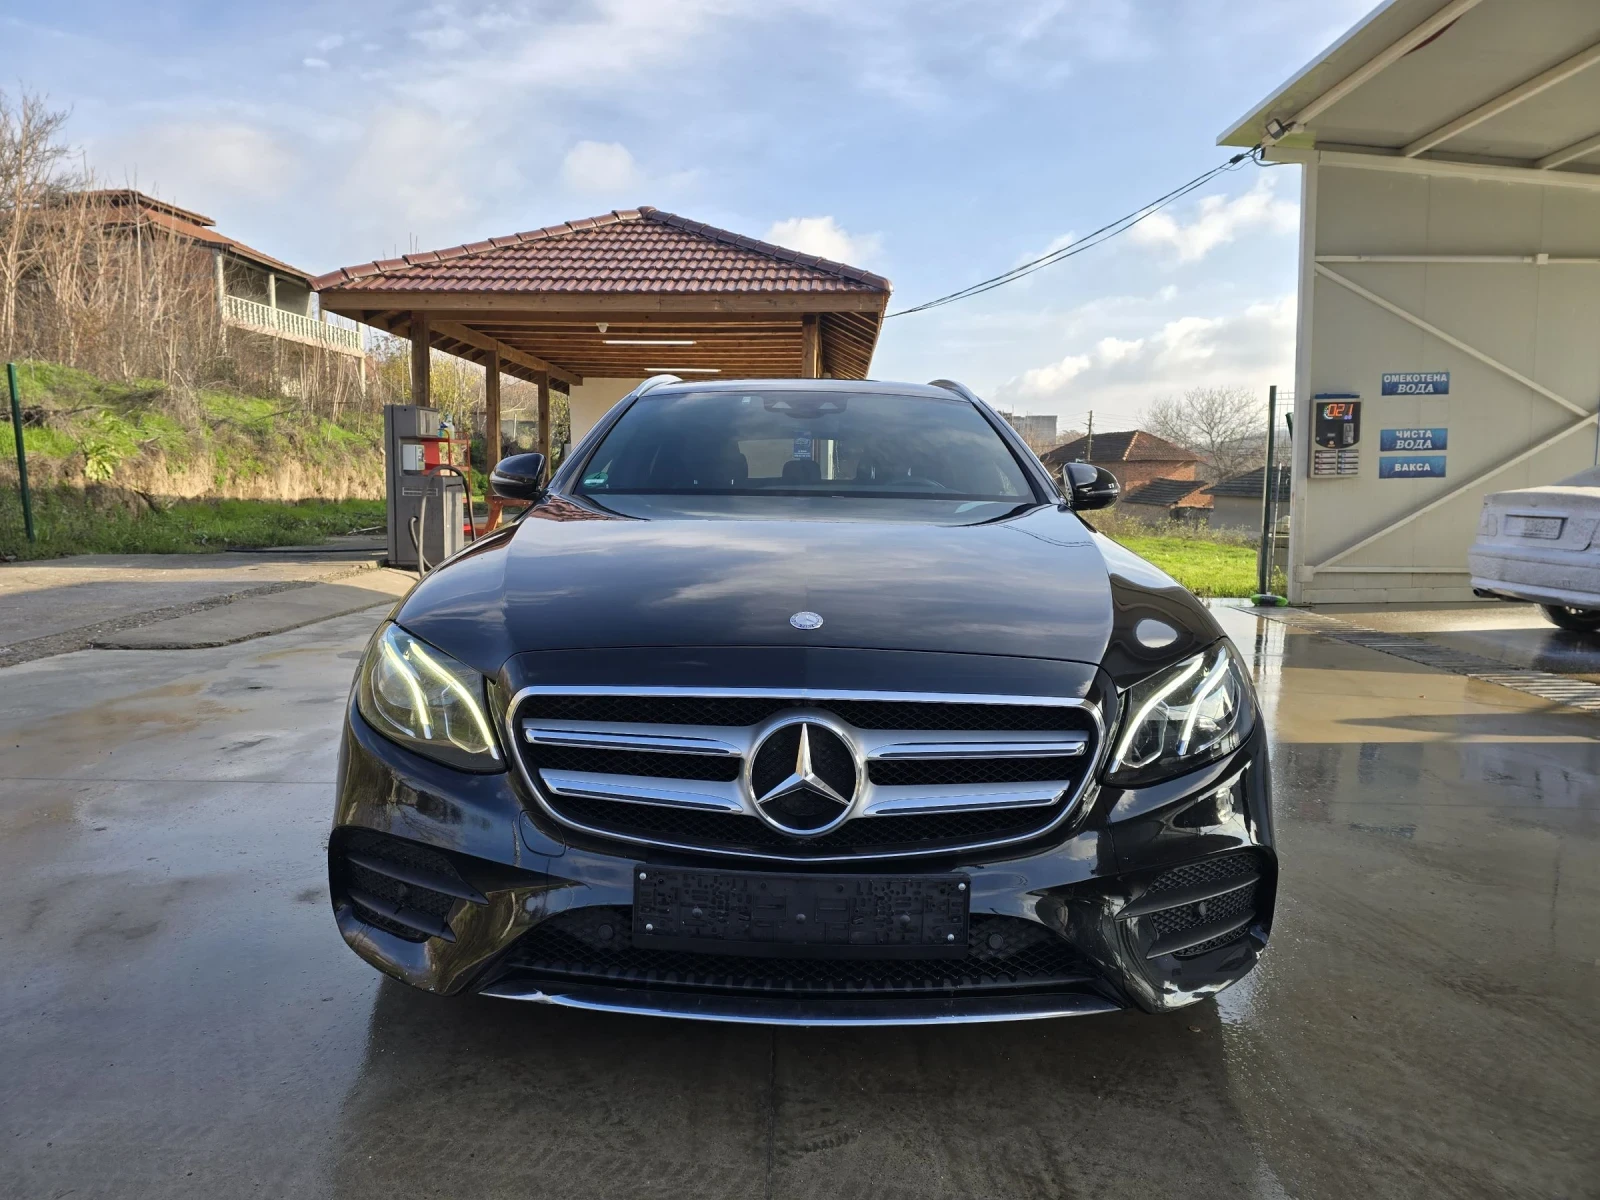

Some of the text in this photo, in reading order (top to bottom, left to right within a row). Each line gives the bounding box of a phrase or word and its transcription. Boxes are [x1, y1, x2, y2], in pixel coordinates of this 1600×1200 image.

[1383, 374, 1448, 383] ОМЕКОТЕНА
[1397, 383, 1434, 394] ВОДА
[1395, 430, 1433, 438] ЧИСТА
[1395, 439, 1433, 450] ВОДА
[1394, 463, 1431, 472] ВАКСА
